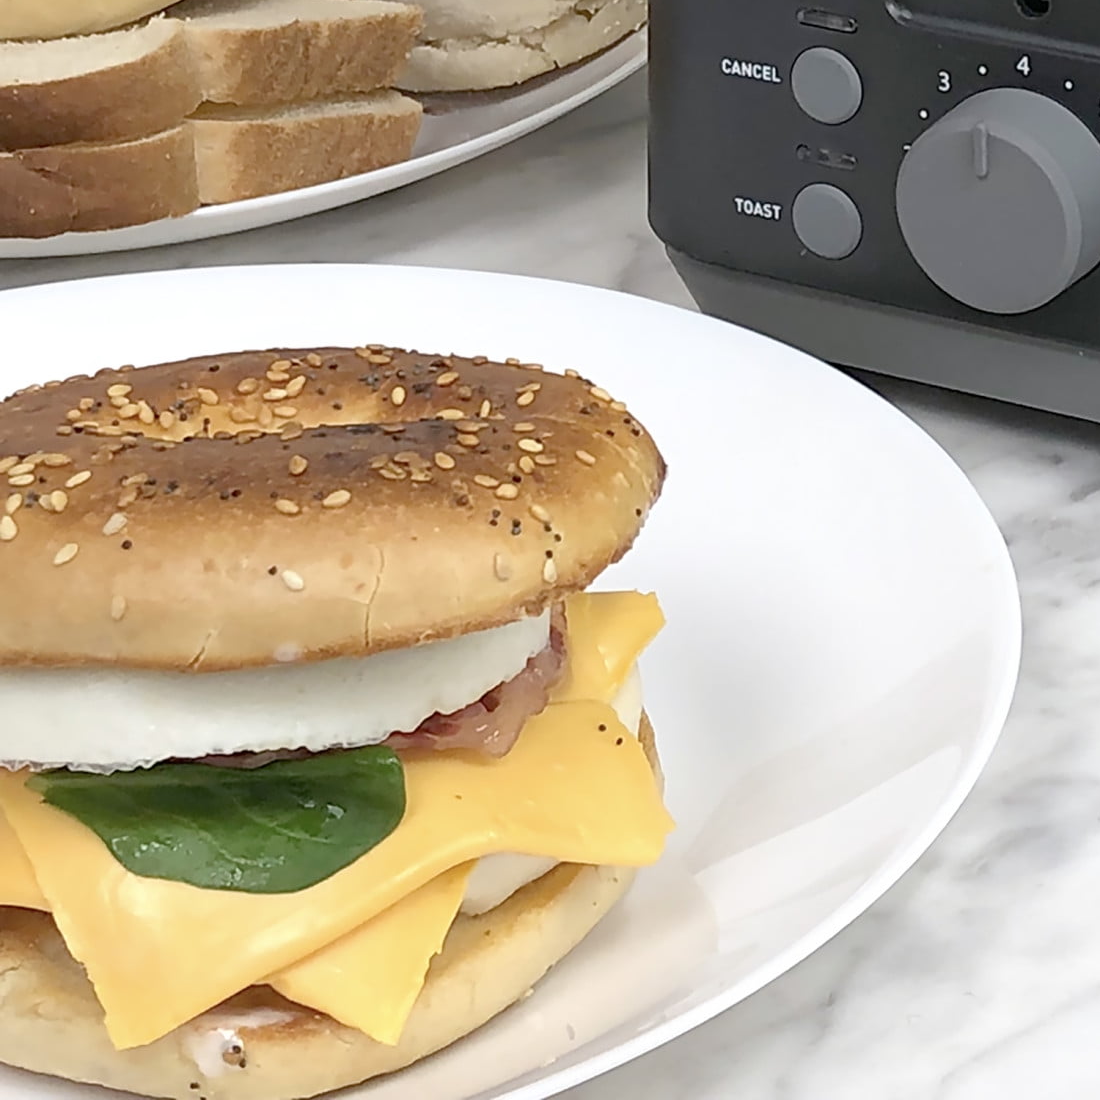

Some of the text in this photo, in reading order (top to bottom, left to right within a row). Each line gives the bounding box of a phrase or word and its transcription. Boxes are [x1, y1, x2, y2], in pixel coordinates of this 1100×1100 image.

[721, 58, 781, 83] CANCEL
[1016, 56, 1030, 75] 4
[938, 71, 950, 92] 3
[734, 197, 781, 220] TOAST
